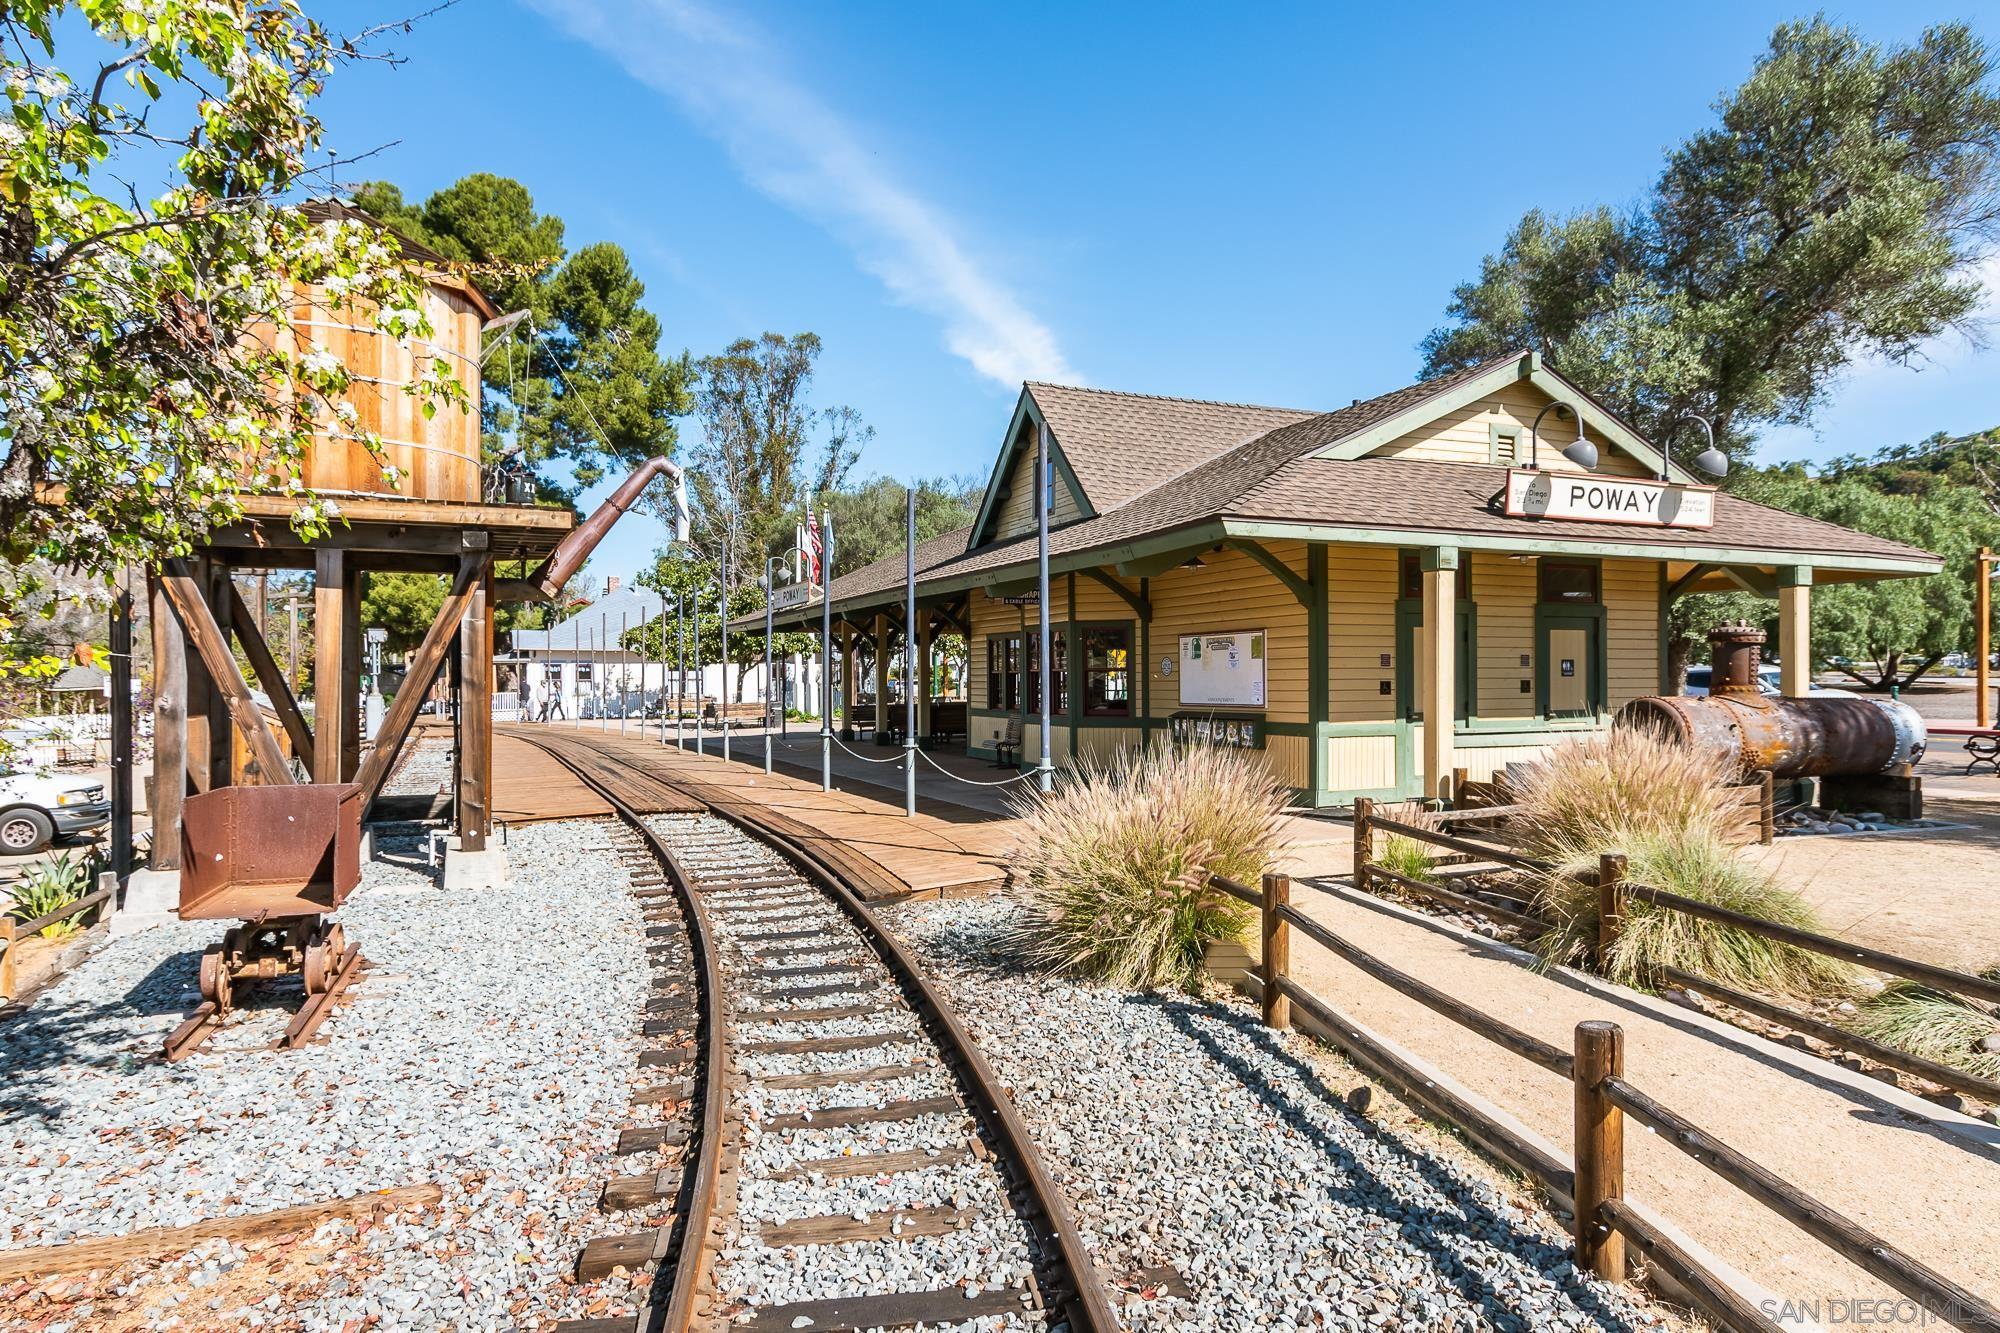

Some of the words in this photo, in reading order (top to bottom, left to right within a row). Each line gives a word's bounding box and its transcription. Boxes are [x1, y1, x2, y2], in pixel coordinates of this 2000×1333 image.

[1528, 489, 1548, 499] Diego
[1570, 486, 1658, 512] POWAY
[783, 588, 799, 602] POWAY
